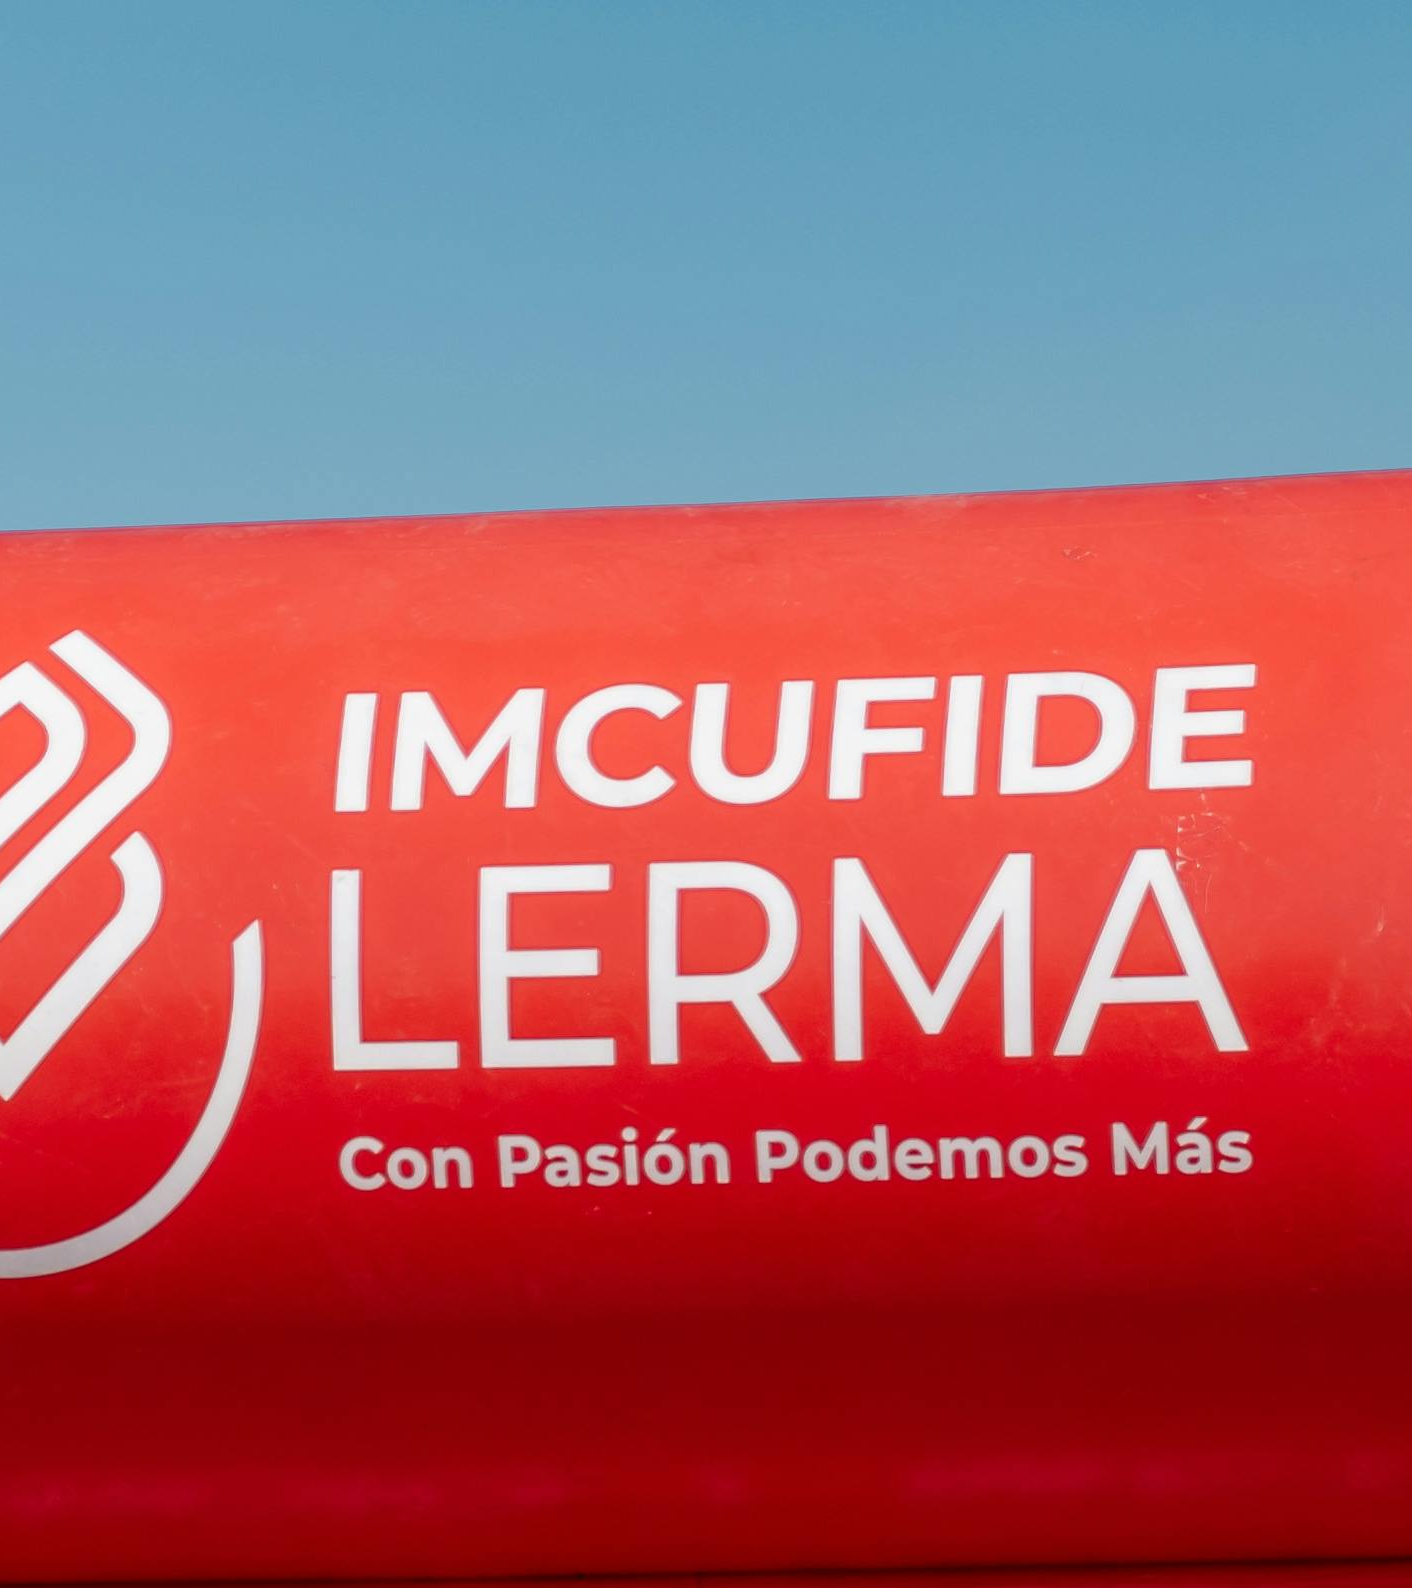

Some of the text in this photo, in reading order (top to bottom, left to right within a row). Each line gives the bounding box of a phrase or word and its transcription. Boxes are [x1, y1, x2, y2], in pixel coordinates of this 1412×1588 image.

[333, 662, 1258, 814] IMCUFIDE
[329, 847, 1249, 1072] LERMA
[339, 1116, 1253, 1190] Con Pasión Podemos Más
